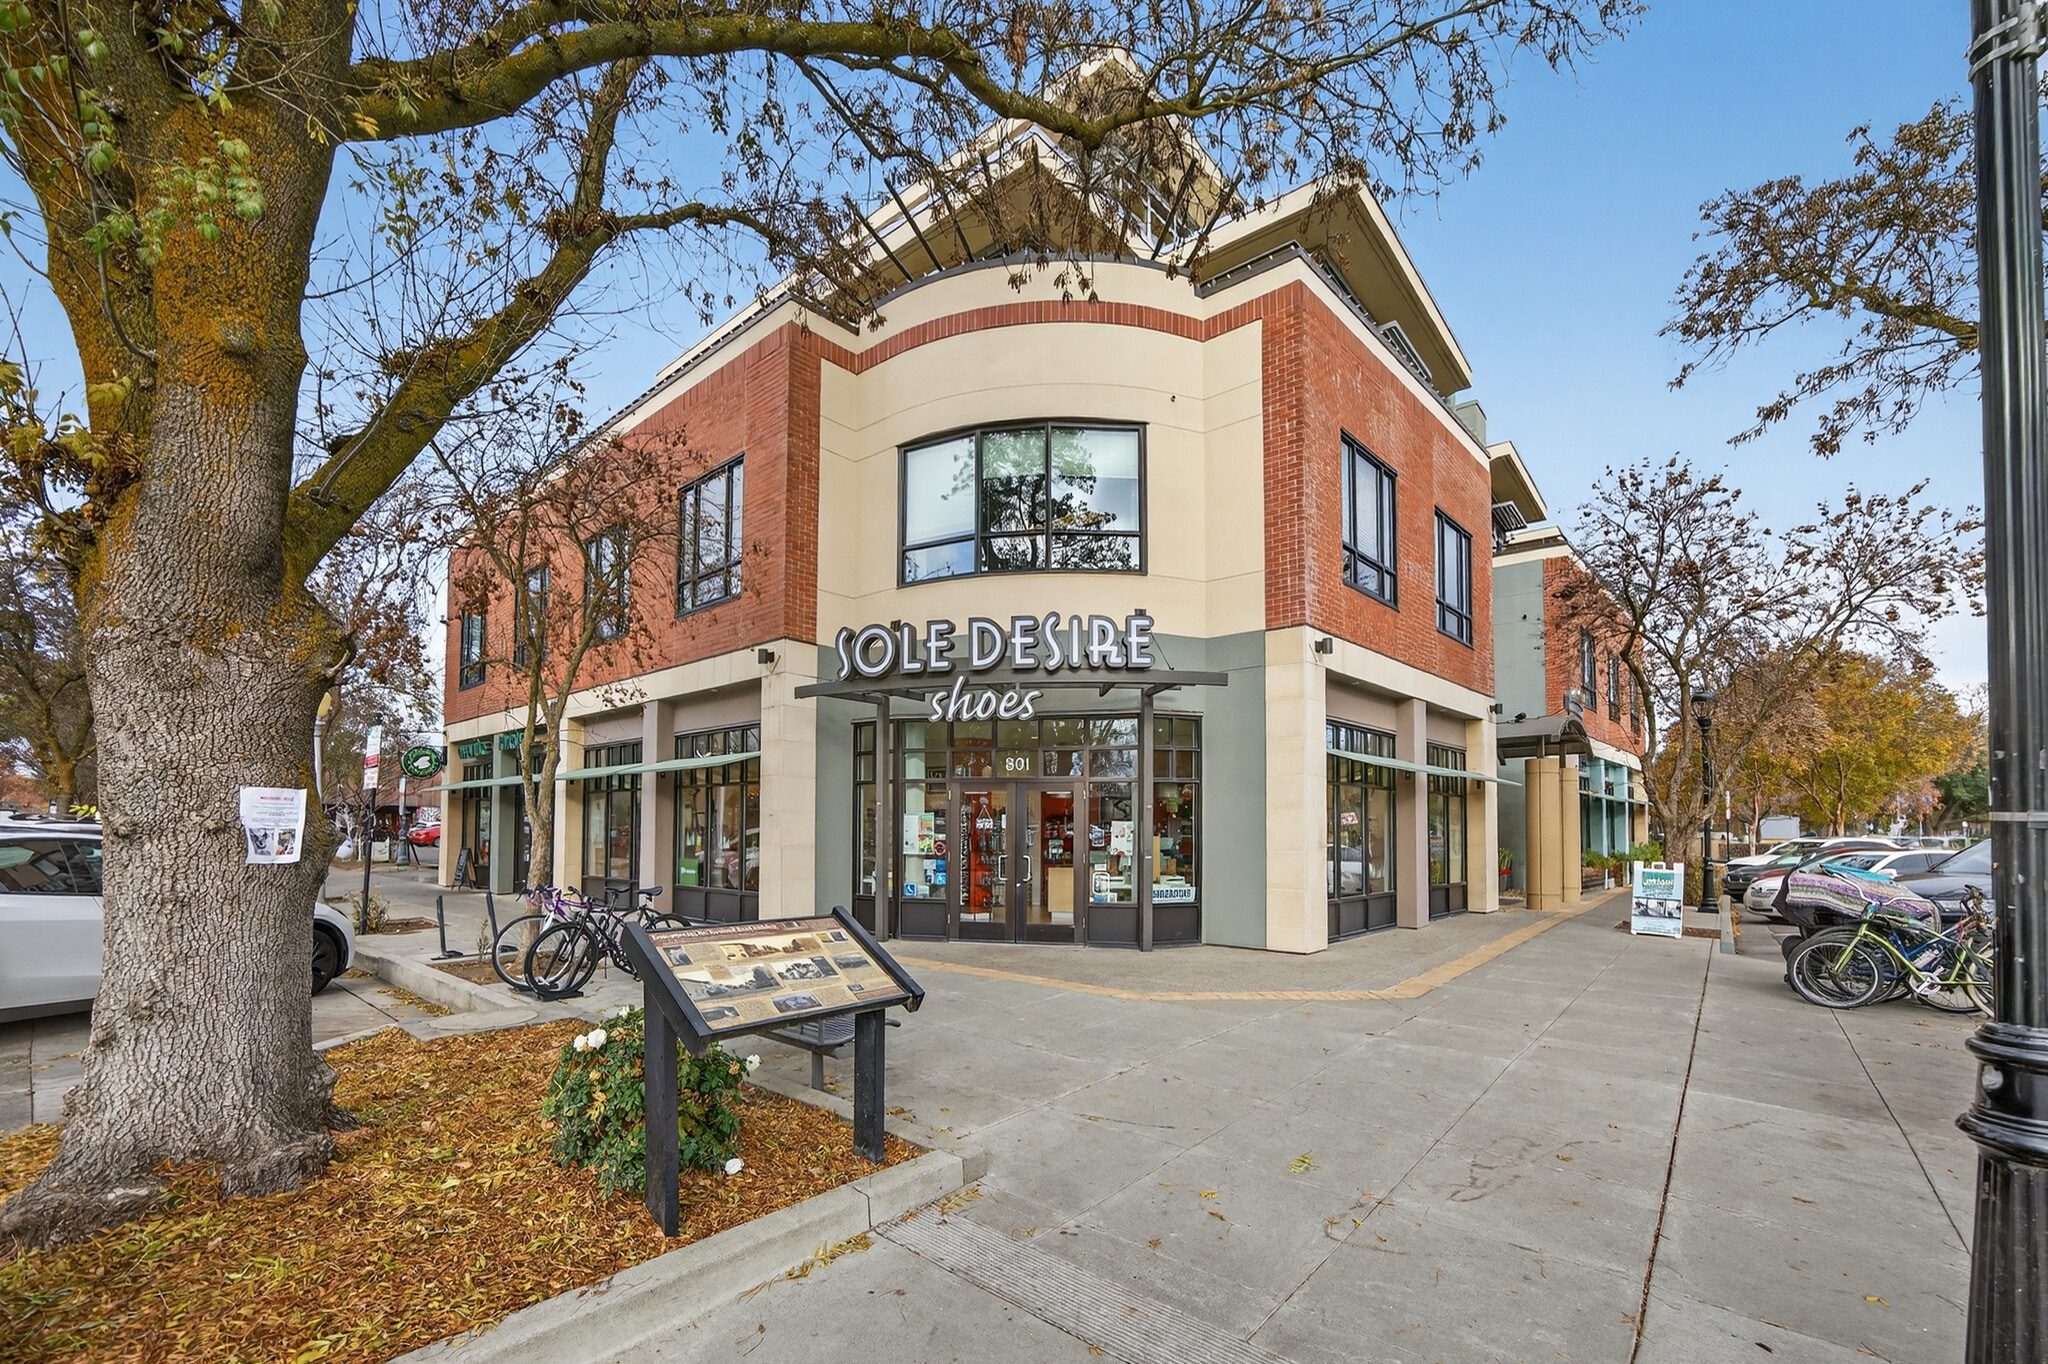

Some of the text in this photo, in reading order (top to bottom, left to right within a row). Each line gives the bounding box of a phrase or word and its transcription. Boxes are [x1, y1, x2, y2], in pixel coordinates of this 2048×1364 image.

[836, 612, 1155, 681] SOLE DESIRE
[928, 675, 1043, 723] shoes
[1005, 756, 1030, 772] 801
